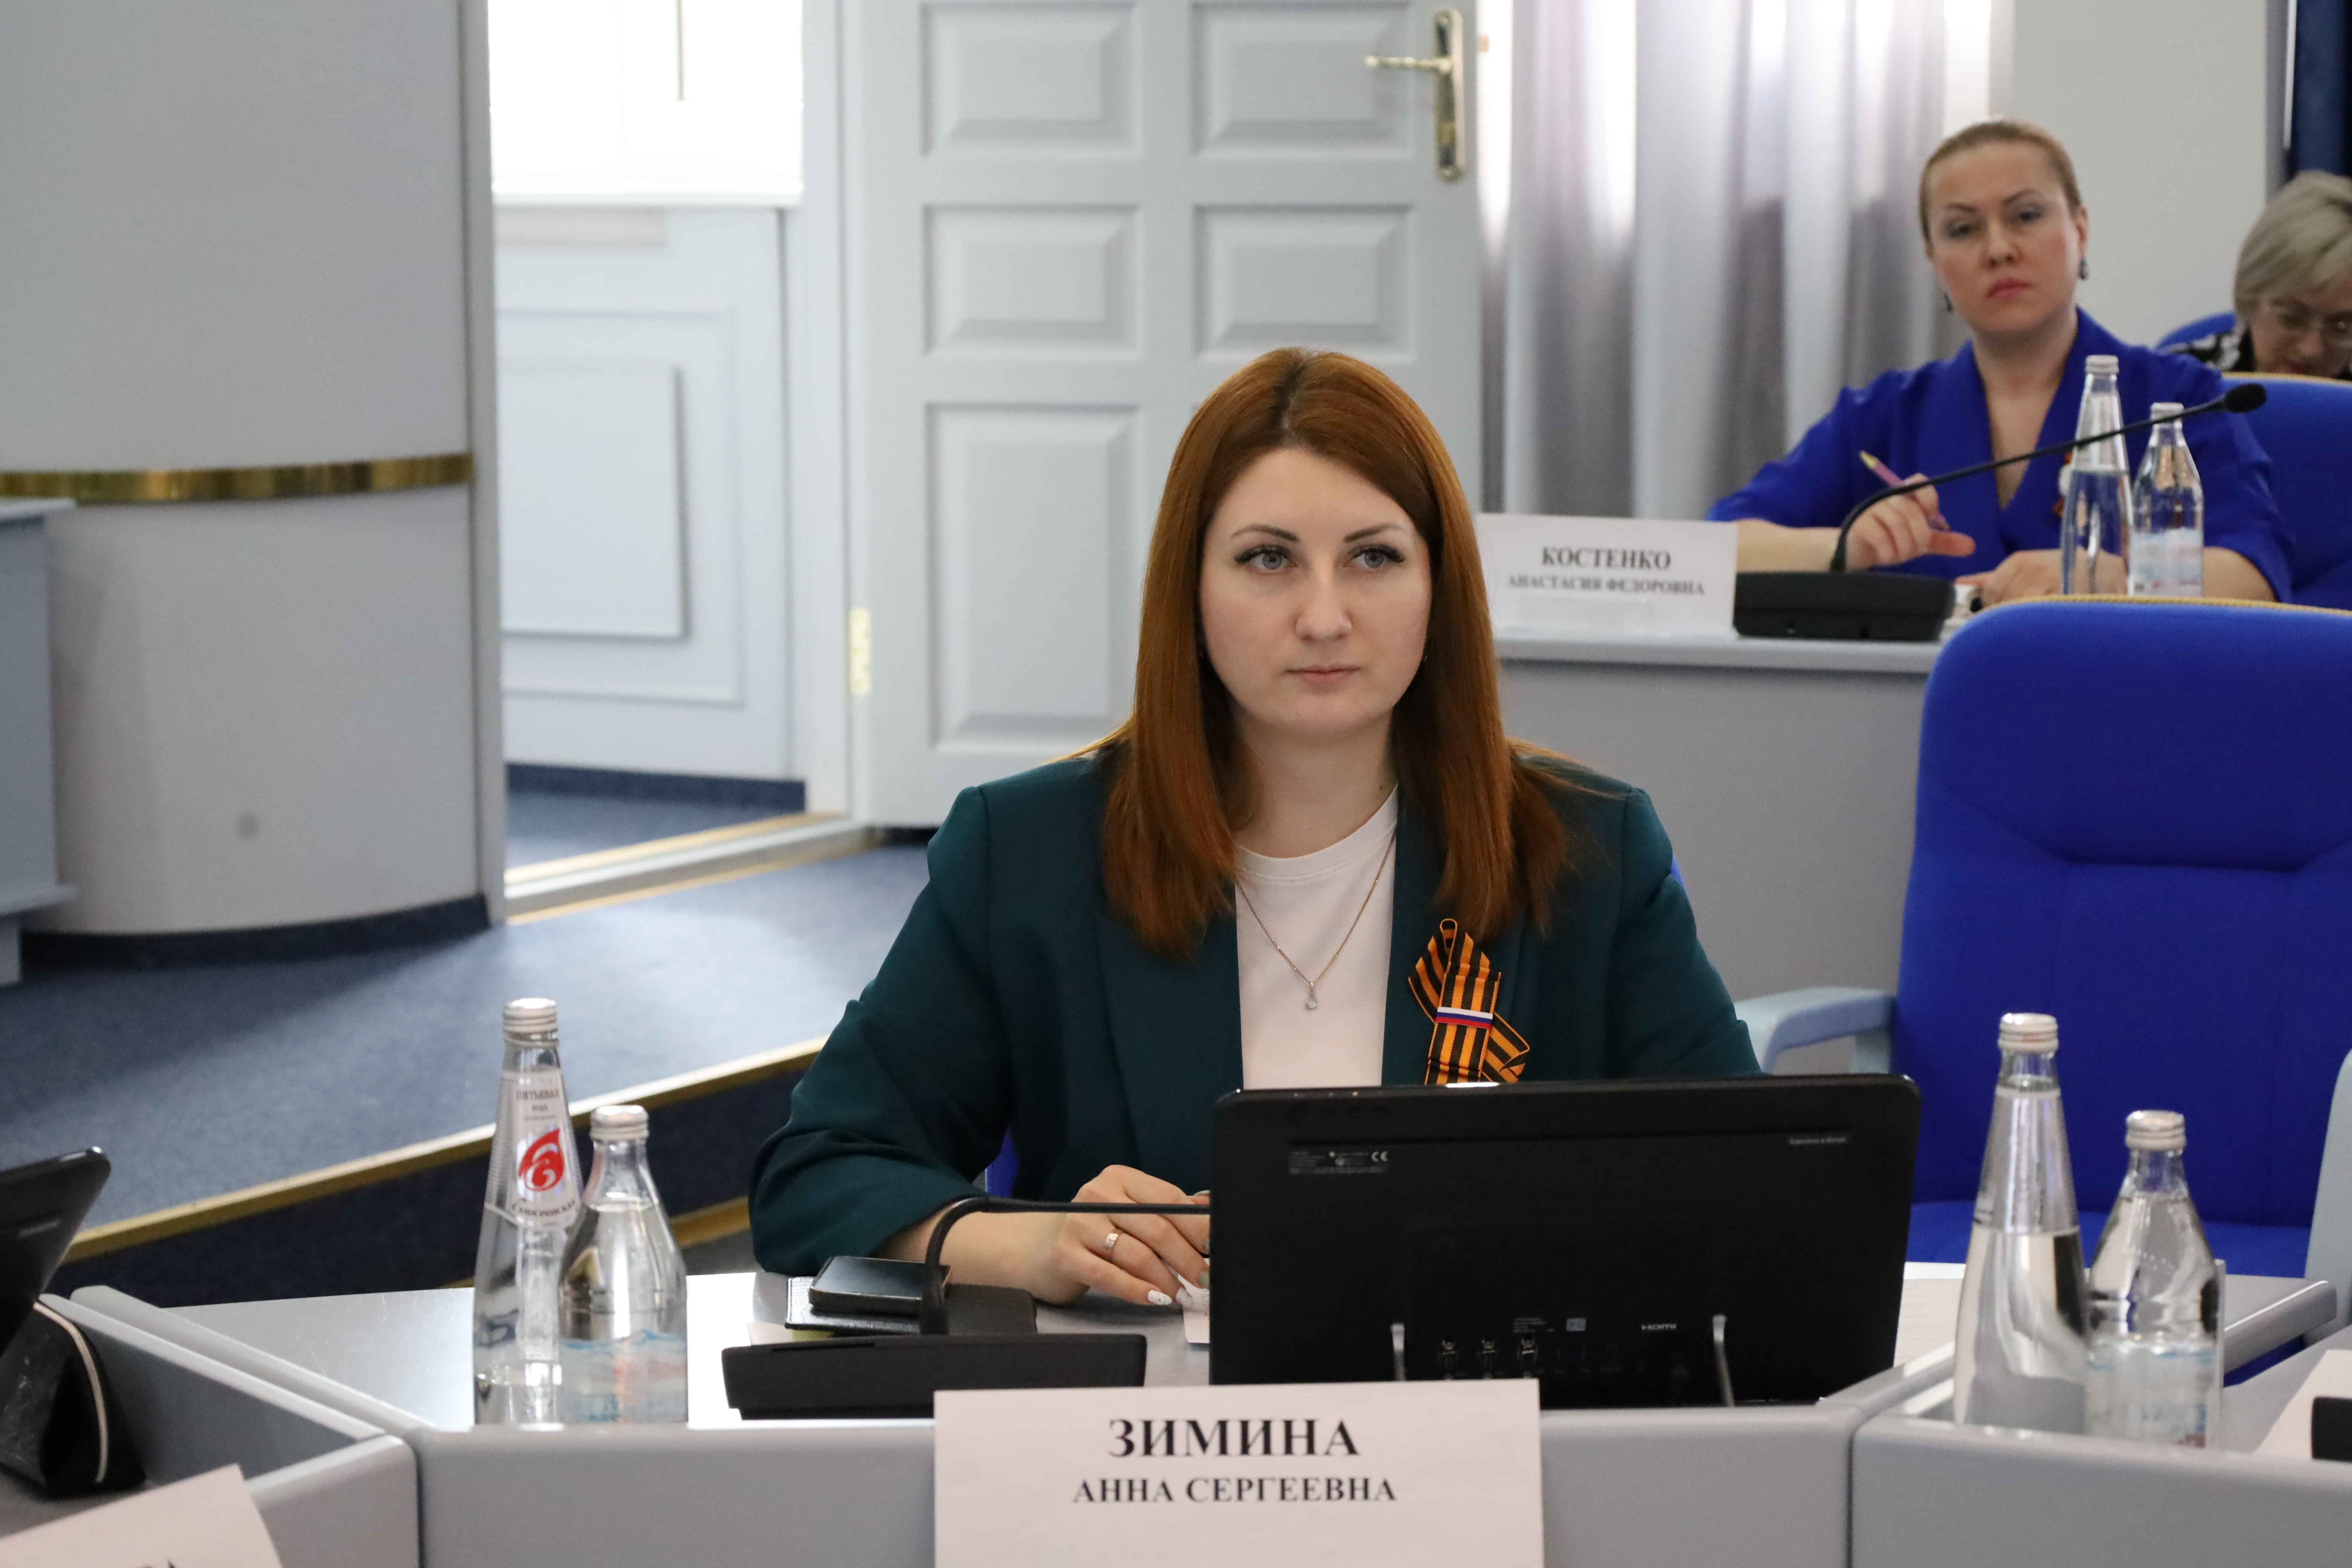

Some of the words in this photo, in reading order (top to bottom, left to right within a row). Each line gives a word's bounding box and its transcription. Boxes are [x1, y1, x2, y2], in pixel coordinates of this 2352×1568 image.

[1541, 546, 1672, 570] КОСТЕНКО
[1508, 574, 1602, 591] АНАСТАСИЯ
[1606, 578, 1705, 596] ФЕДОРОВНА
[1108, 1418, 1360, 1458] ЗИМИНА
[1073, 1478, 1174, 1502] АННА
[1185, 1477, 1396, 1502] СЕРГЕЕВНА
